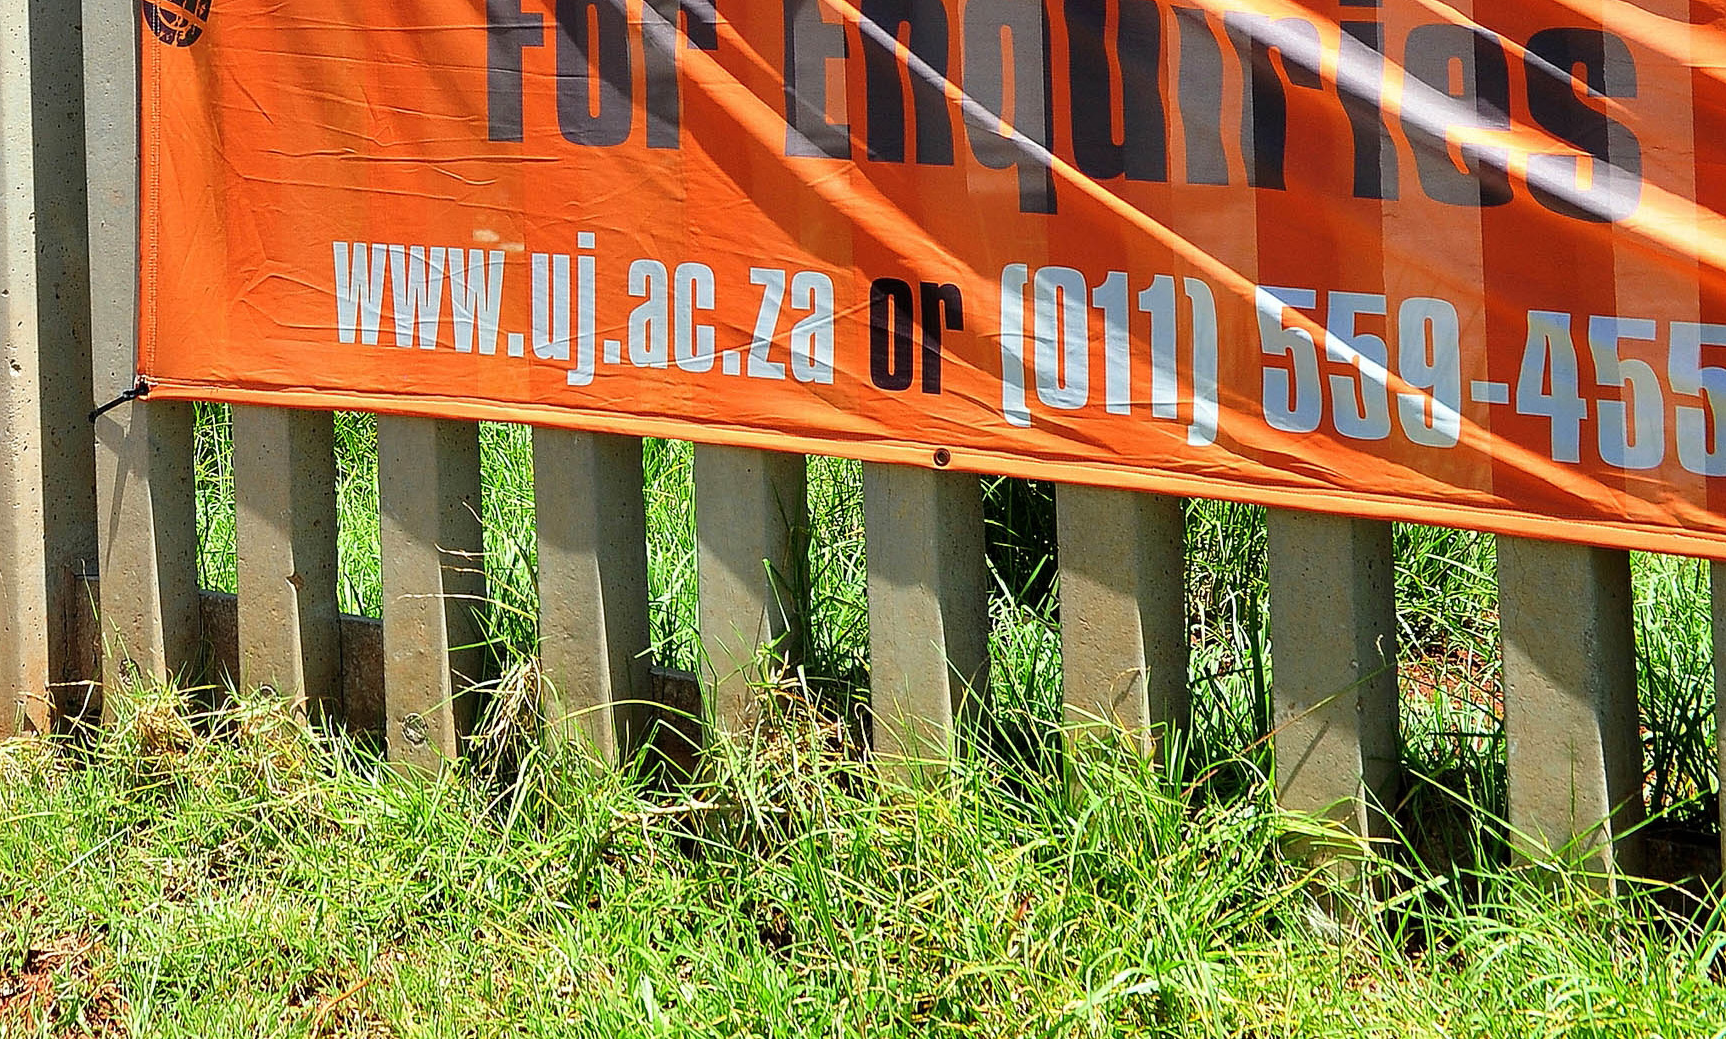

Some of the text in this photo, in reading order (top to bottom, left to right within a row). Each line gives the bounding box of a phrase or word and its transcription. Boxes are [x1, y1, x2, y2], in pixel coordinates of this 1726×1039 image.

[332, 232, 1726, 476] www.uj.ac.za or (011) 559-455
